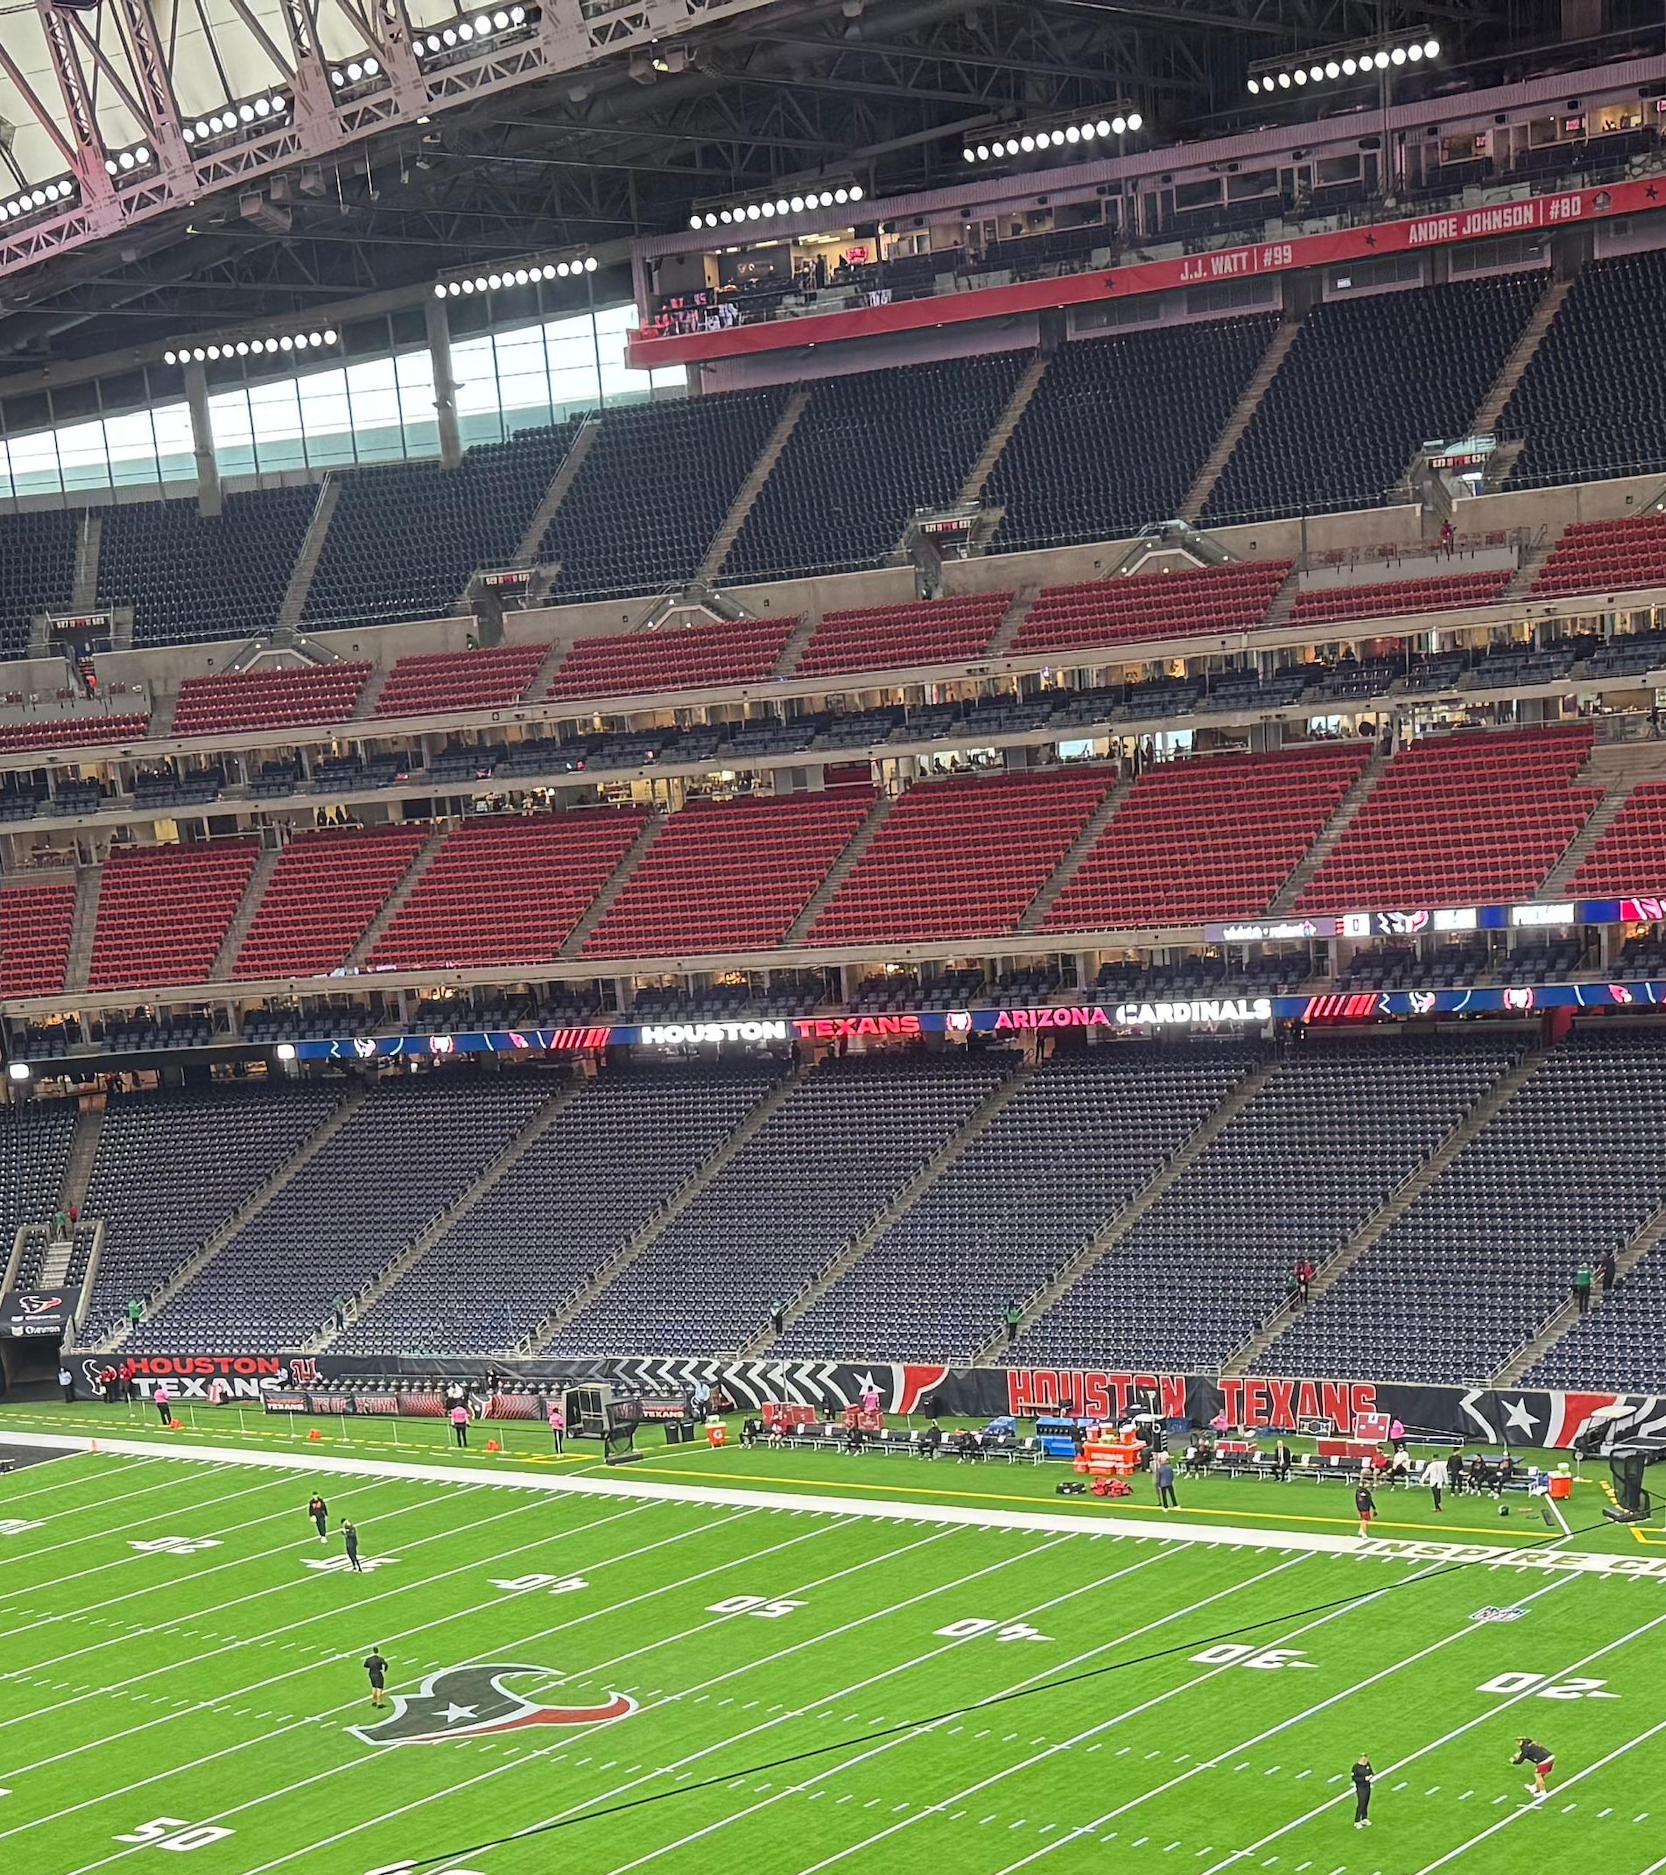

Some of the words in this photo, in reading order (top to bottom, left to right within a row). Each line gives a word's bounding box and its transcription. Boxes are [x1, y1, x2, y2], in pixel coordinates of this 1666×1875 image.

[1408, 219, 1458, 245] ANDRE
[1461, 205, 1534, 236] JOHNSON
[1548, 195, 1582, 219] #80
[1180, 260, 1207, 282] J.J.
[1210, 250, 1249, 275] WATT
[1262, 244, 1293, 267] #99
[640, 1021, 786, 1045] HOUSTON
[792, 1015, 921, 1038] TEXANS
[993, 1008, 1111, 1031] ARIZONA
[1115, 998, 1272, 1026] CARDINALS
[127, 1356, 281, 1375] HOUSTON
[132, 1376, 283, 1398] TEXANS
[1007, 1368, 1187, 1419] HOUSTON
[1217, 1377, 1379, 1435] TEXANS
[1351, 1538, 1592, 1571] INSPIRE
[112, 1817, 238, 1853] 50
